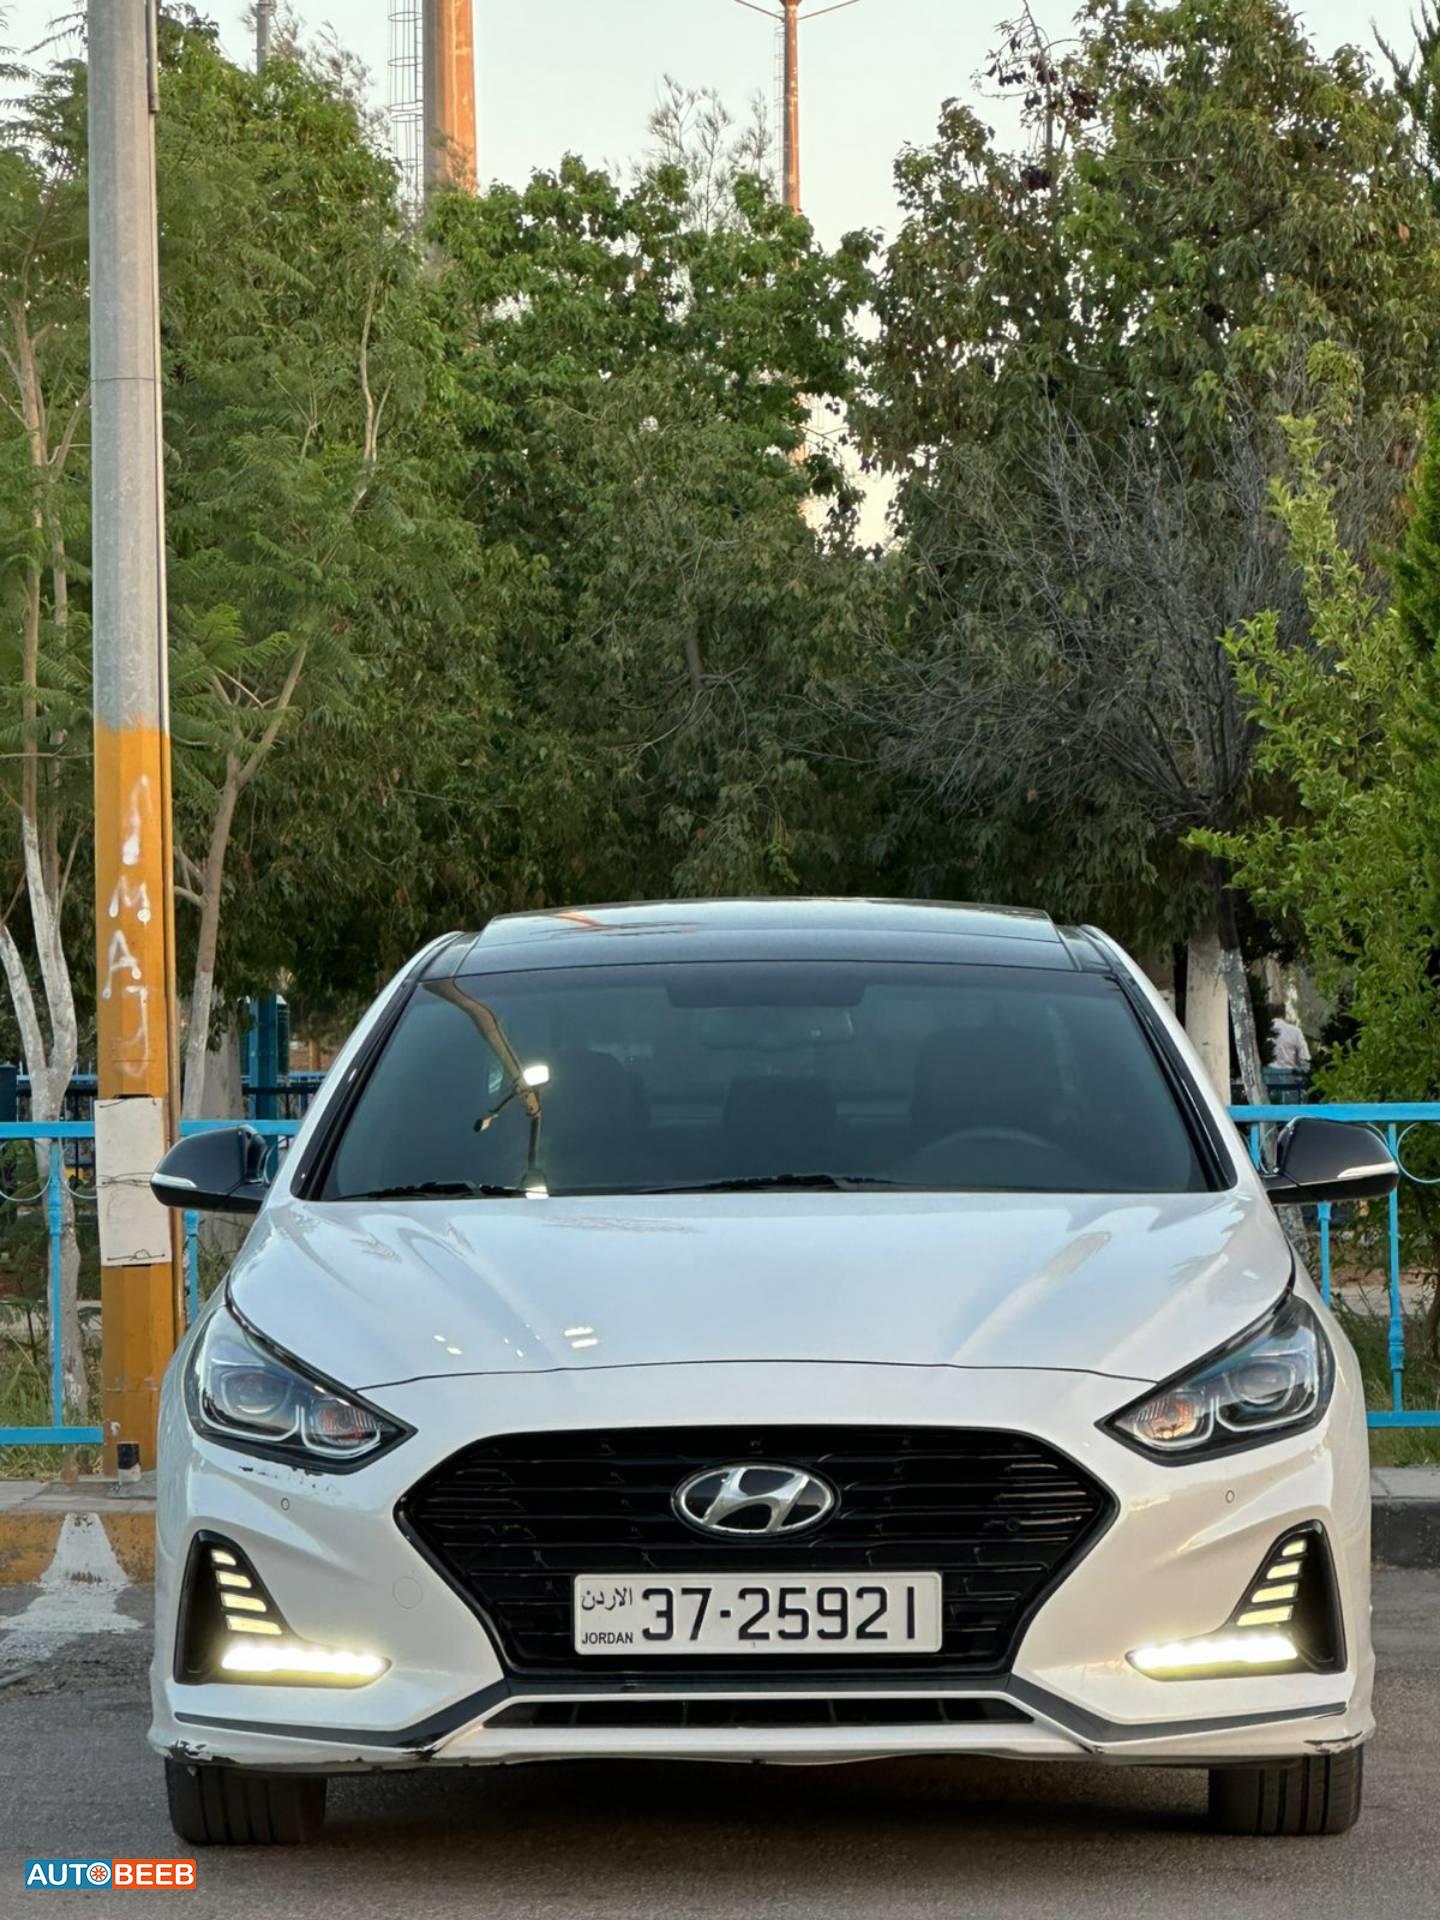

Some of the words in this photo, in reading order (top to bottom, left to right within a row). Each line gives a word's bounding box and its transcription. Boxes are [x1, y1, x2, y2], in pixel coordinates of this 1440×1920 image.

[581, 1587, 633, 1611] الاردن
[641, 1586, 916, 1641] 37-25921
[581, 1631, 634, 1645] JORDAN
